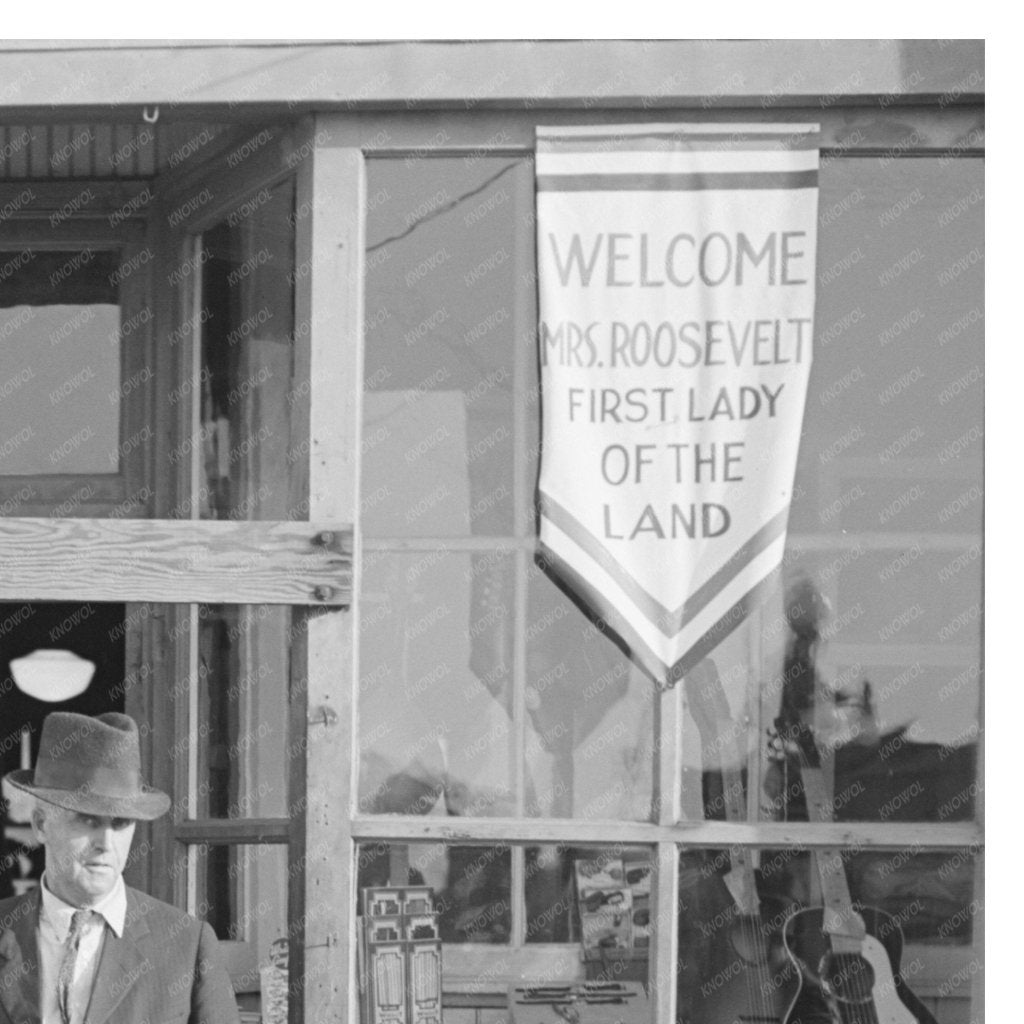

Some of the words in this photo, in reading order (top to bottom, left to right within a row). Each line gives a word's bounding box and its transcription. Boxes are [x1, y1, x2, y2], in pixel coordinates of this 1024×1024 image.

[548, 231, 807, 287] WELCOME
[541, 320, 604, 368] MRS.
[610, 318, 812, 368] ROOSEVELT
[568, 387, 674, 423] FIRST
[688, 383, 785, 422] LADY
[601, 443, 657, 486] OF
[667, 442, 745, 484] THE
[603, 502, 731, 541] LAND
